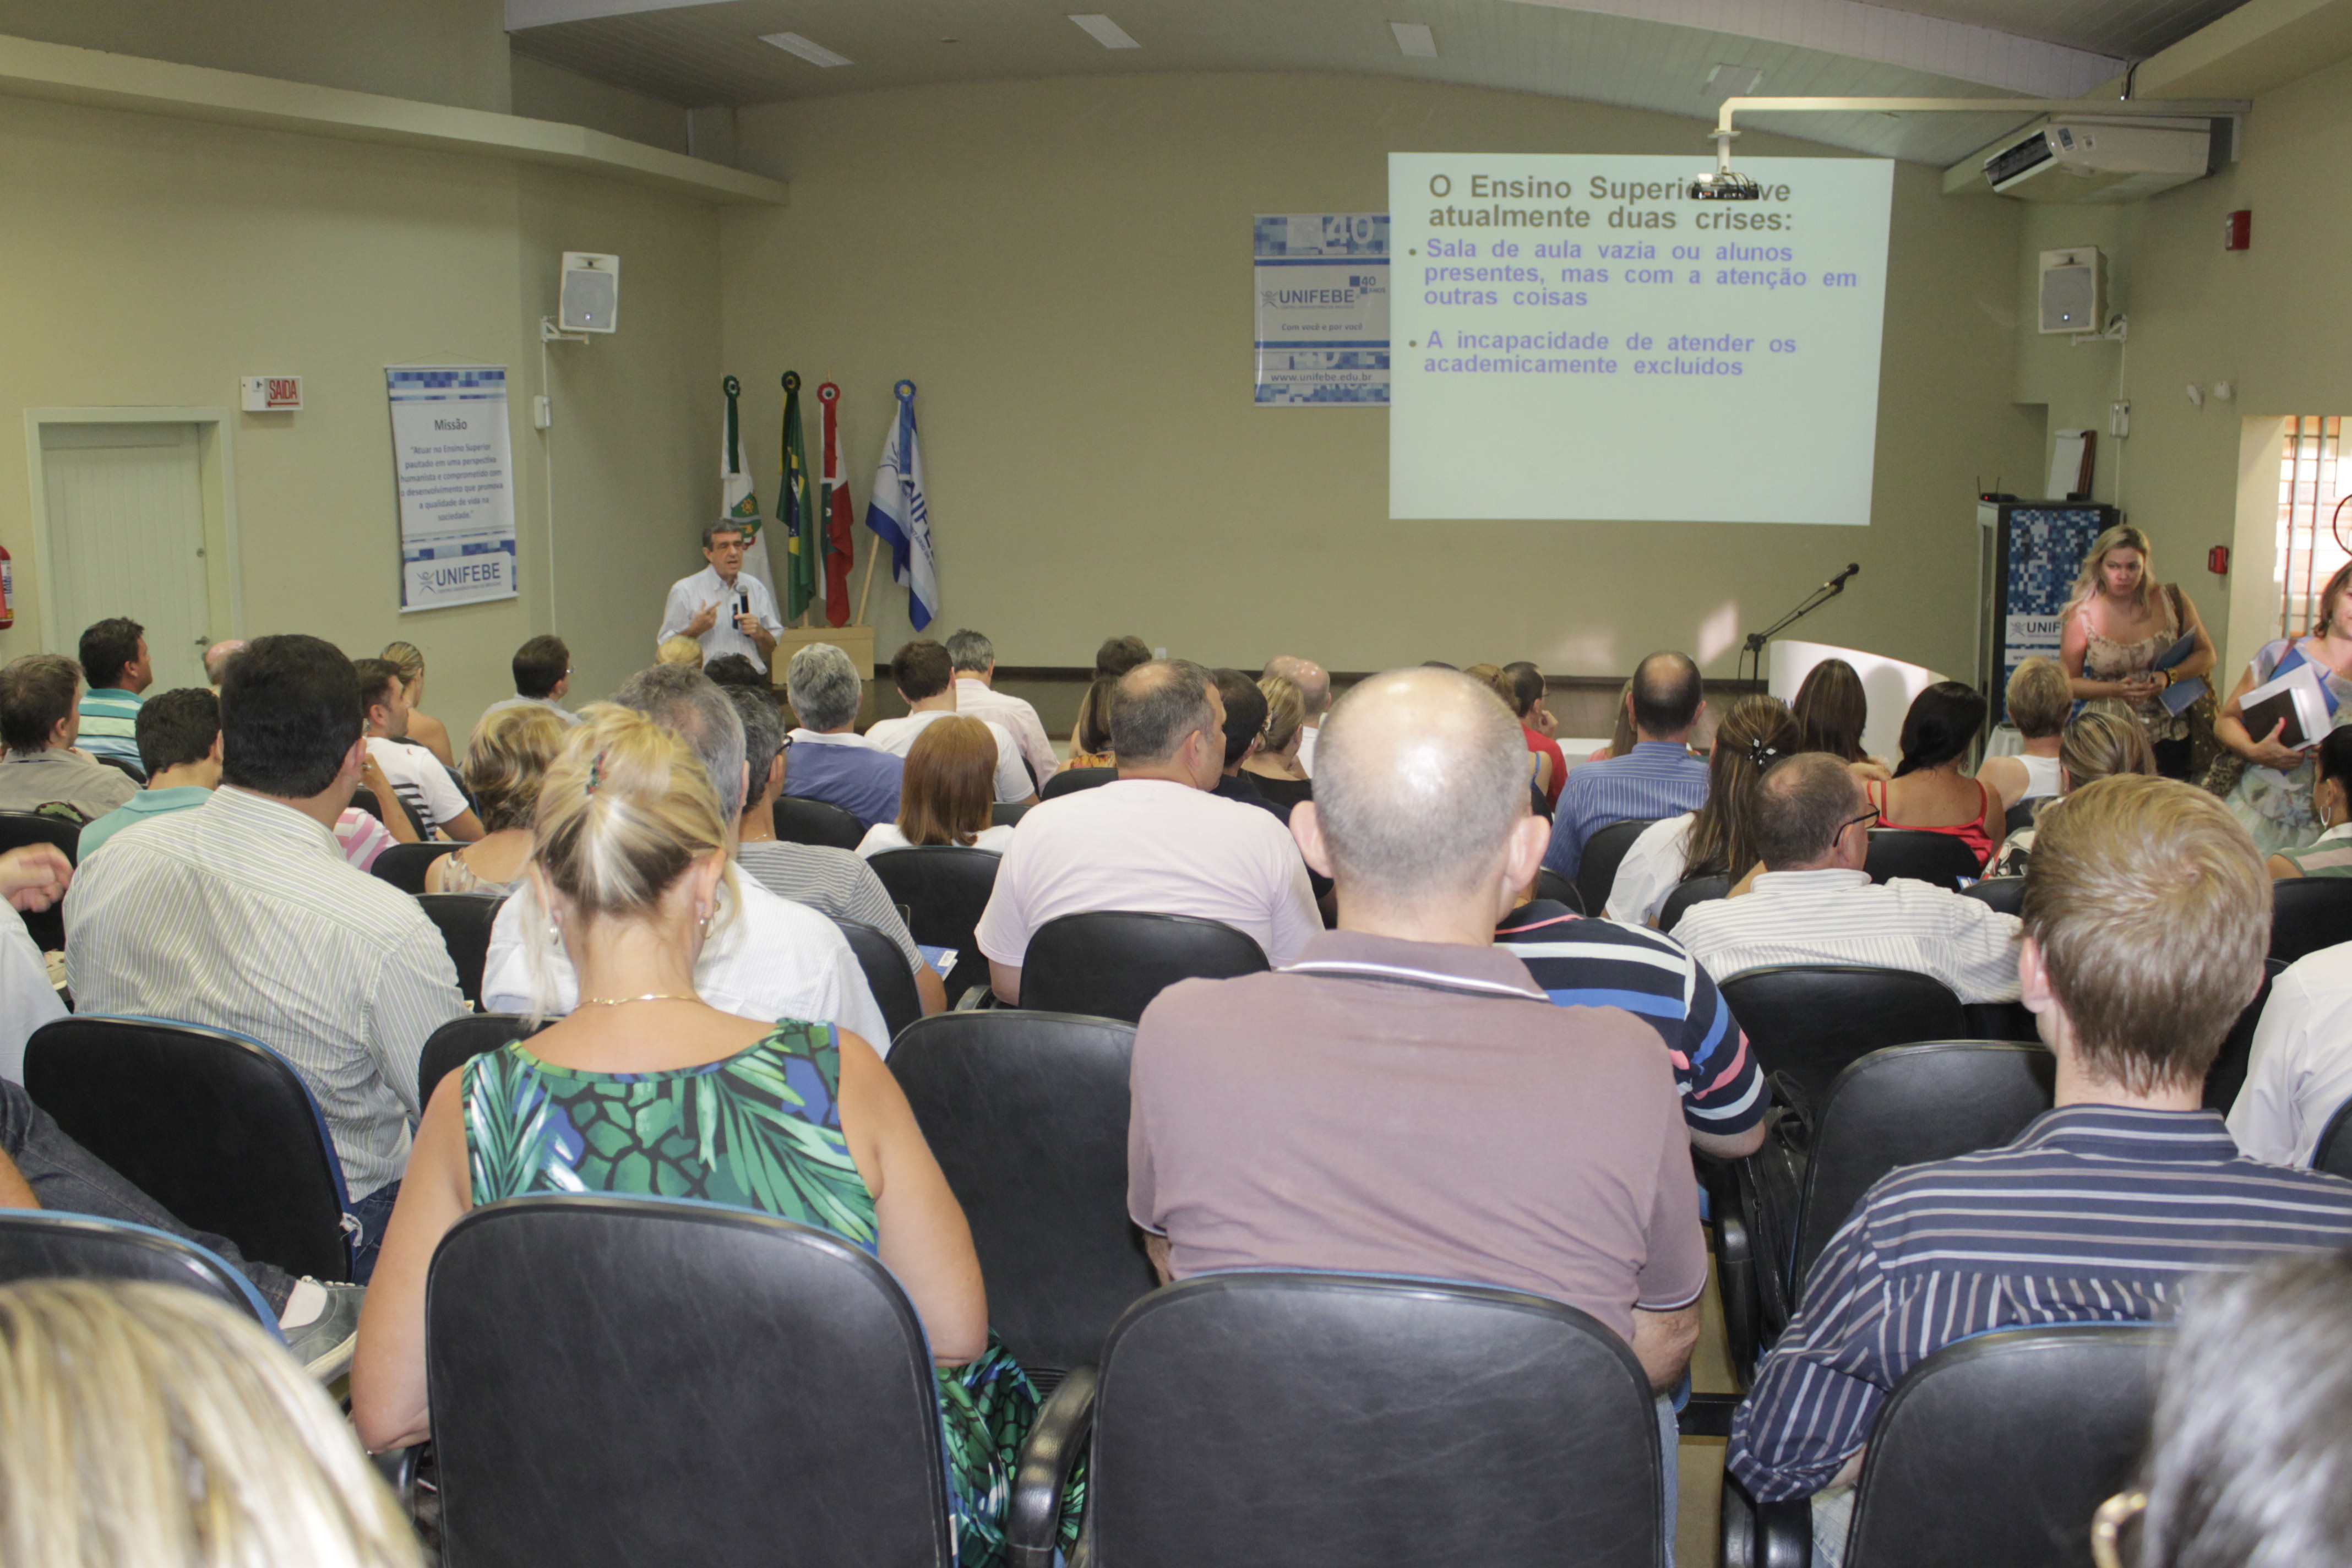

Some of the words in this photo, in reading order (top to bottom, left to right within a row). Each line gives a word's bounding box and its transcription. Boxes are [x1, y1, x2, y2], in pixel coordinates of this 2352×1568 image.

[1429, 174, 1452, 198] O
[1471, 175, 1572, 199] Ensino
[1589, 176, 1693, 205] Superi
[1758, 184, 1791, 202] ve
[1429, 204, 1591, 228] atualmente
[1608, 206, 1676, 229] duas
[1695, 207, 1792, 231] crises:
[1427, 238, 1477, 257] Sala
[1491, 239, 1520, 257] de
[1534, 240, 1582, 258] aula
[1598, 241, 1656, 259] vazia
[1672, 246, 1700, 260] ou
[1716, 242, 1793, 261] alunos
[1361, 276, 1376, 286] 40
[1424, 265, 1545, 286] presentes,
[1561, 269, 1609, 282] mas
[1624, 269, 1674, 284] com
[1689, 270, 1701, 284] a
[1716, 268, 1807, 290] atenção
[1822, 273, 1857, 287] em
[1279, 289, 1354, 303] UNIFEBE
[1424, 288, 1498, 304] outras
[1513, 287, 1588, 306] coisas
[1427, 330, 1444, 348] A
[1457, 330, 1609, 353] incapacidade
[1626, 333, 1653, 350] de
[1667, 334, 1755, 352] atender
[1769, 339, 1796, 353] os
[1424, 352, 1618, 373] academicamente
[1634, 357, 1743, 375] excluídos
[1271, 373, 1372, 382] www.unifebe.edu.br
[434, 418, 467, 431] Missão
[443, 444, 464, 453] Ensino
[465, 444, 491, 453] Superior
[405, 459, 434, 470] pautado
[462, 456, 497, 467] perspectiva
[400, 473, 436, 483] humanista
[443, 471, 488, 480] comprometido
[406, 486, 463, 496] desenvolvimento
[477, 483, 503, 492] promova
[425, 499, 456, 510] qualidade
[435, 562, 501, 586] UNIFEBE
[2027, 622, 2061, 633] UNIF
